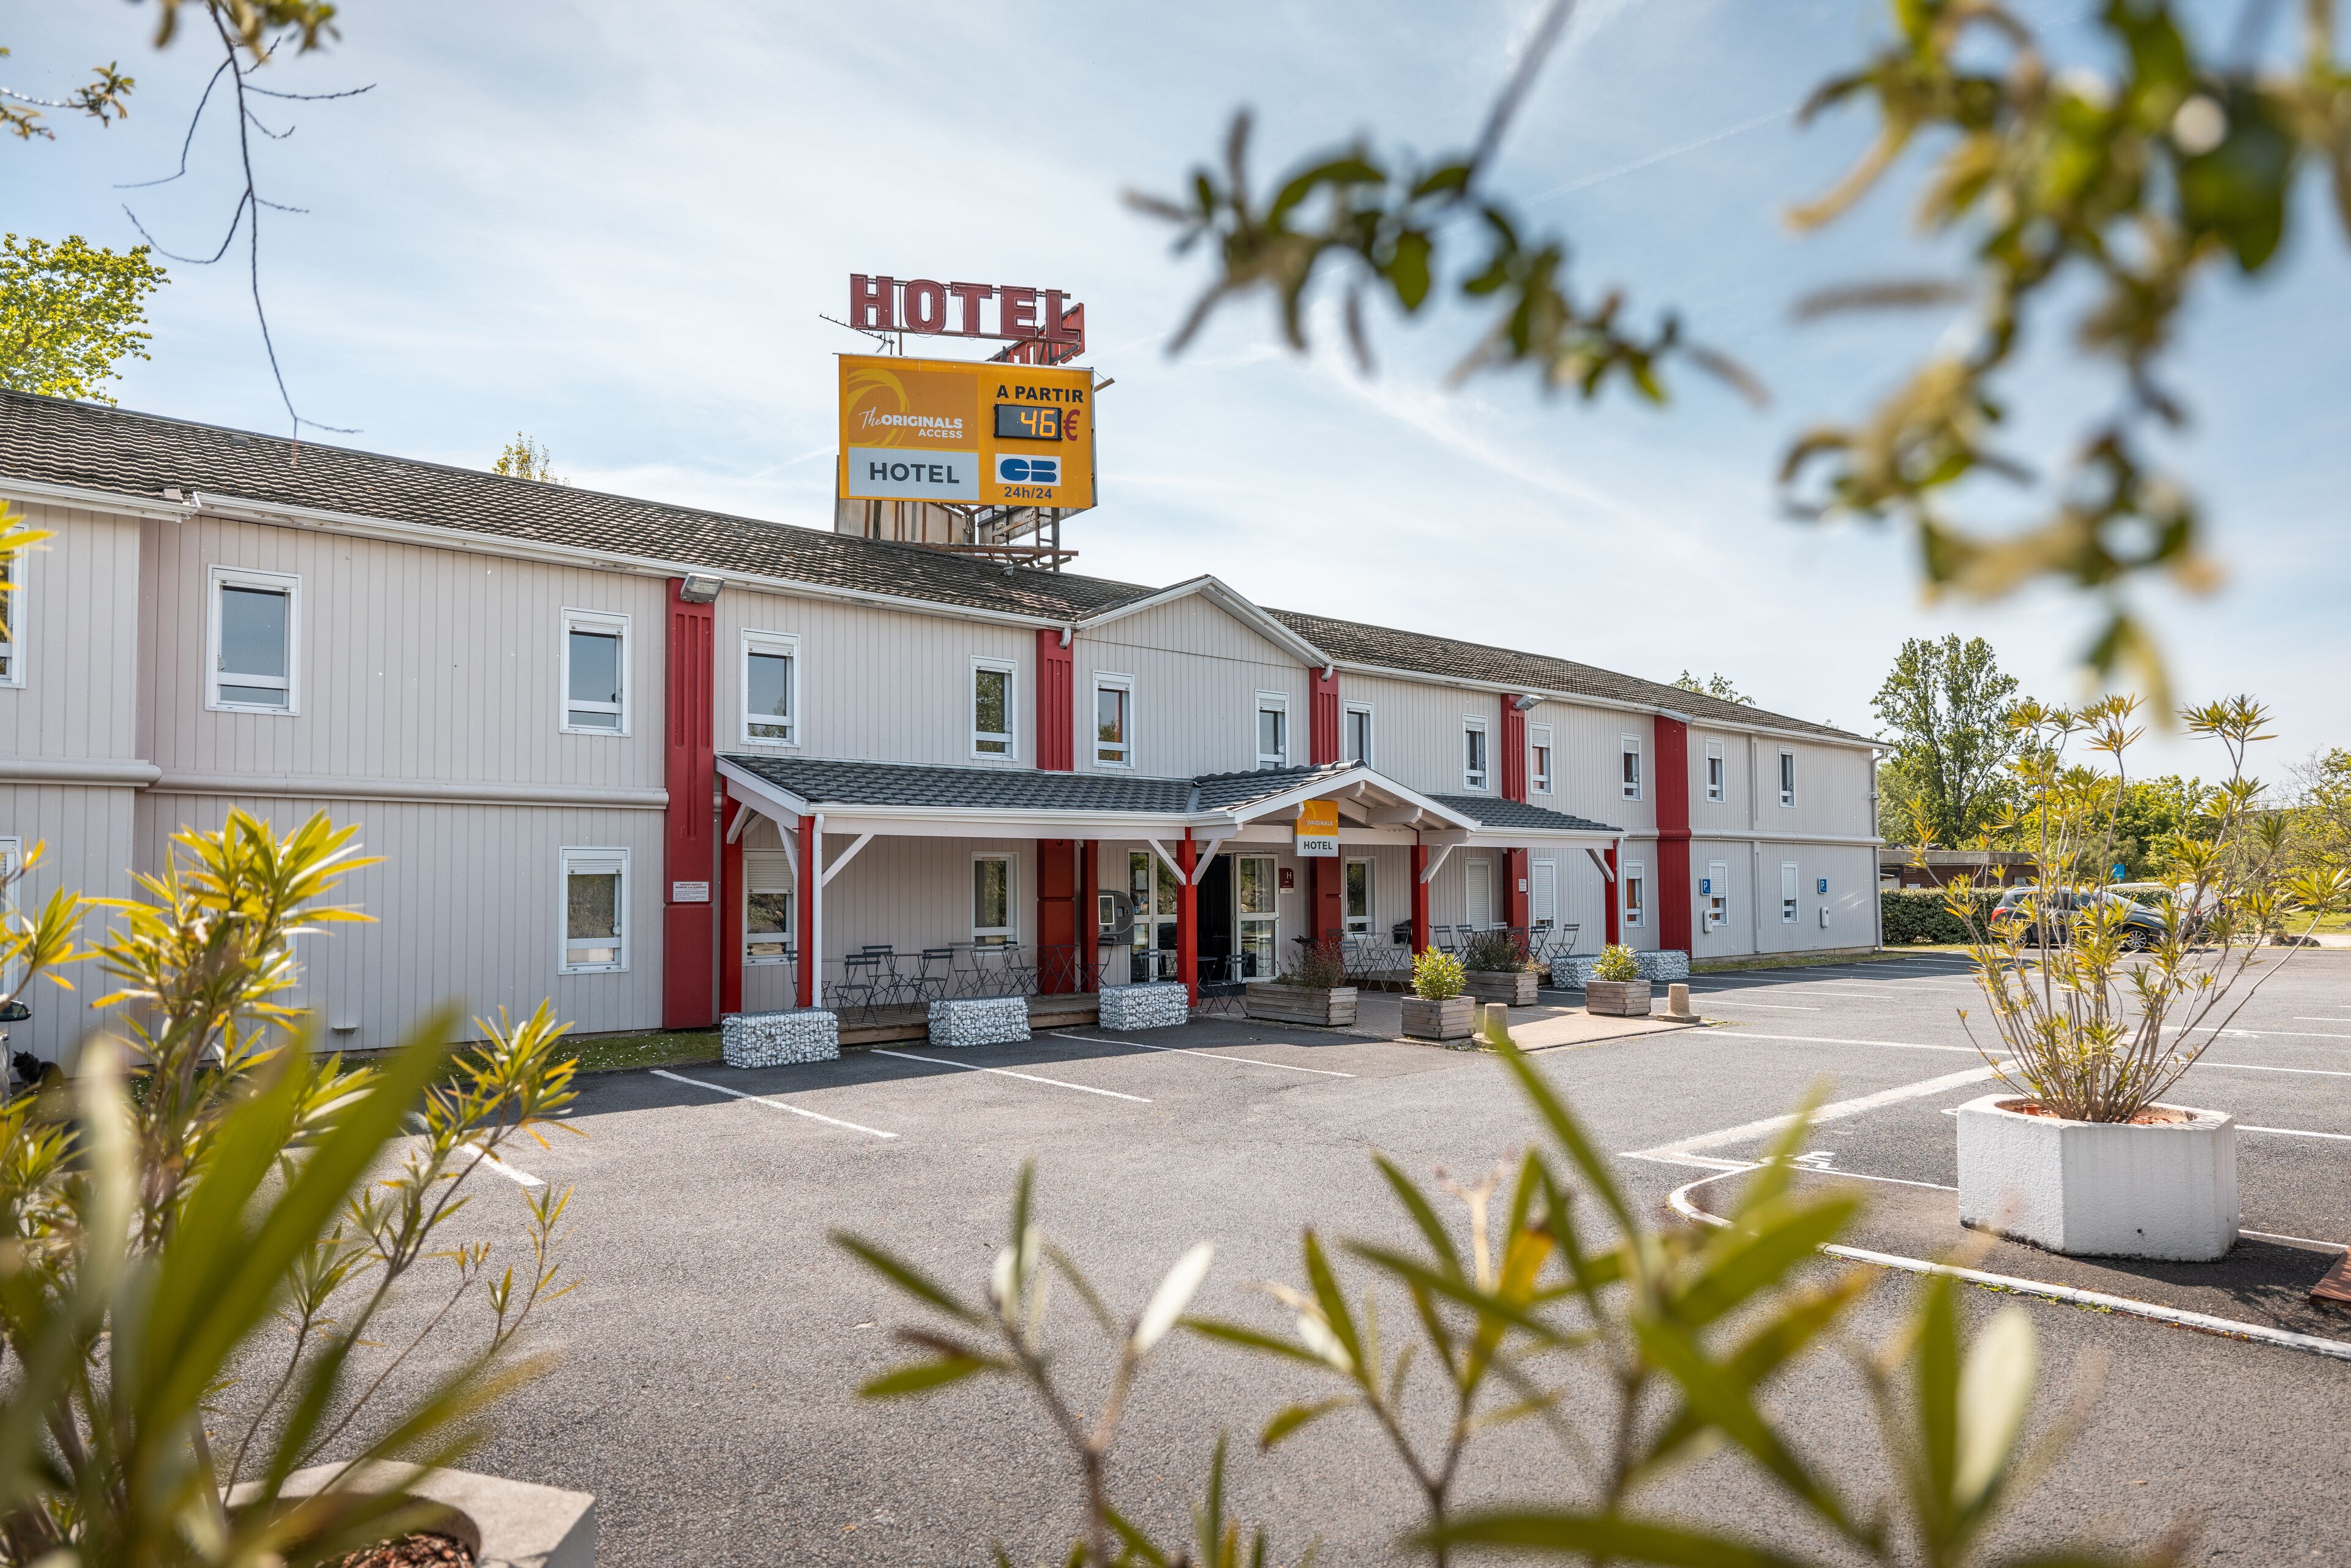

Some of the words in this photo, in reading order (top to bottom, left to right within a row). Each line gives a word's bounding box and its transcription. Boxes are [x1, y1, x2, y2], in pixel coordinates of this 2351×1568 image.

[850, 273, 1081, 342] HOTEL
[996, 384, 1009, 399] A
[1015, 386, 1084, 403] PARTIR
[1021, 410, 1056, 437] 46
[918, 429, 962, 438] ACCESS
[870, 462, 959, 484] HOTEL
[1004, 486, 1052, 499] 24h/24
[1303, 841, 1332, 850] HOTEL
[1703, 880, 1708, 891] P
[1821, 880, 1824, 890] P
